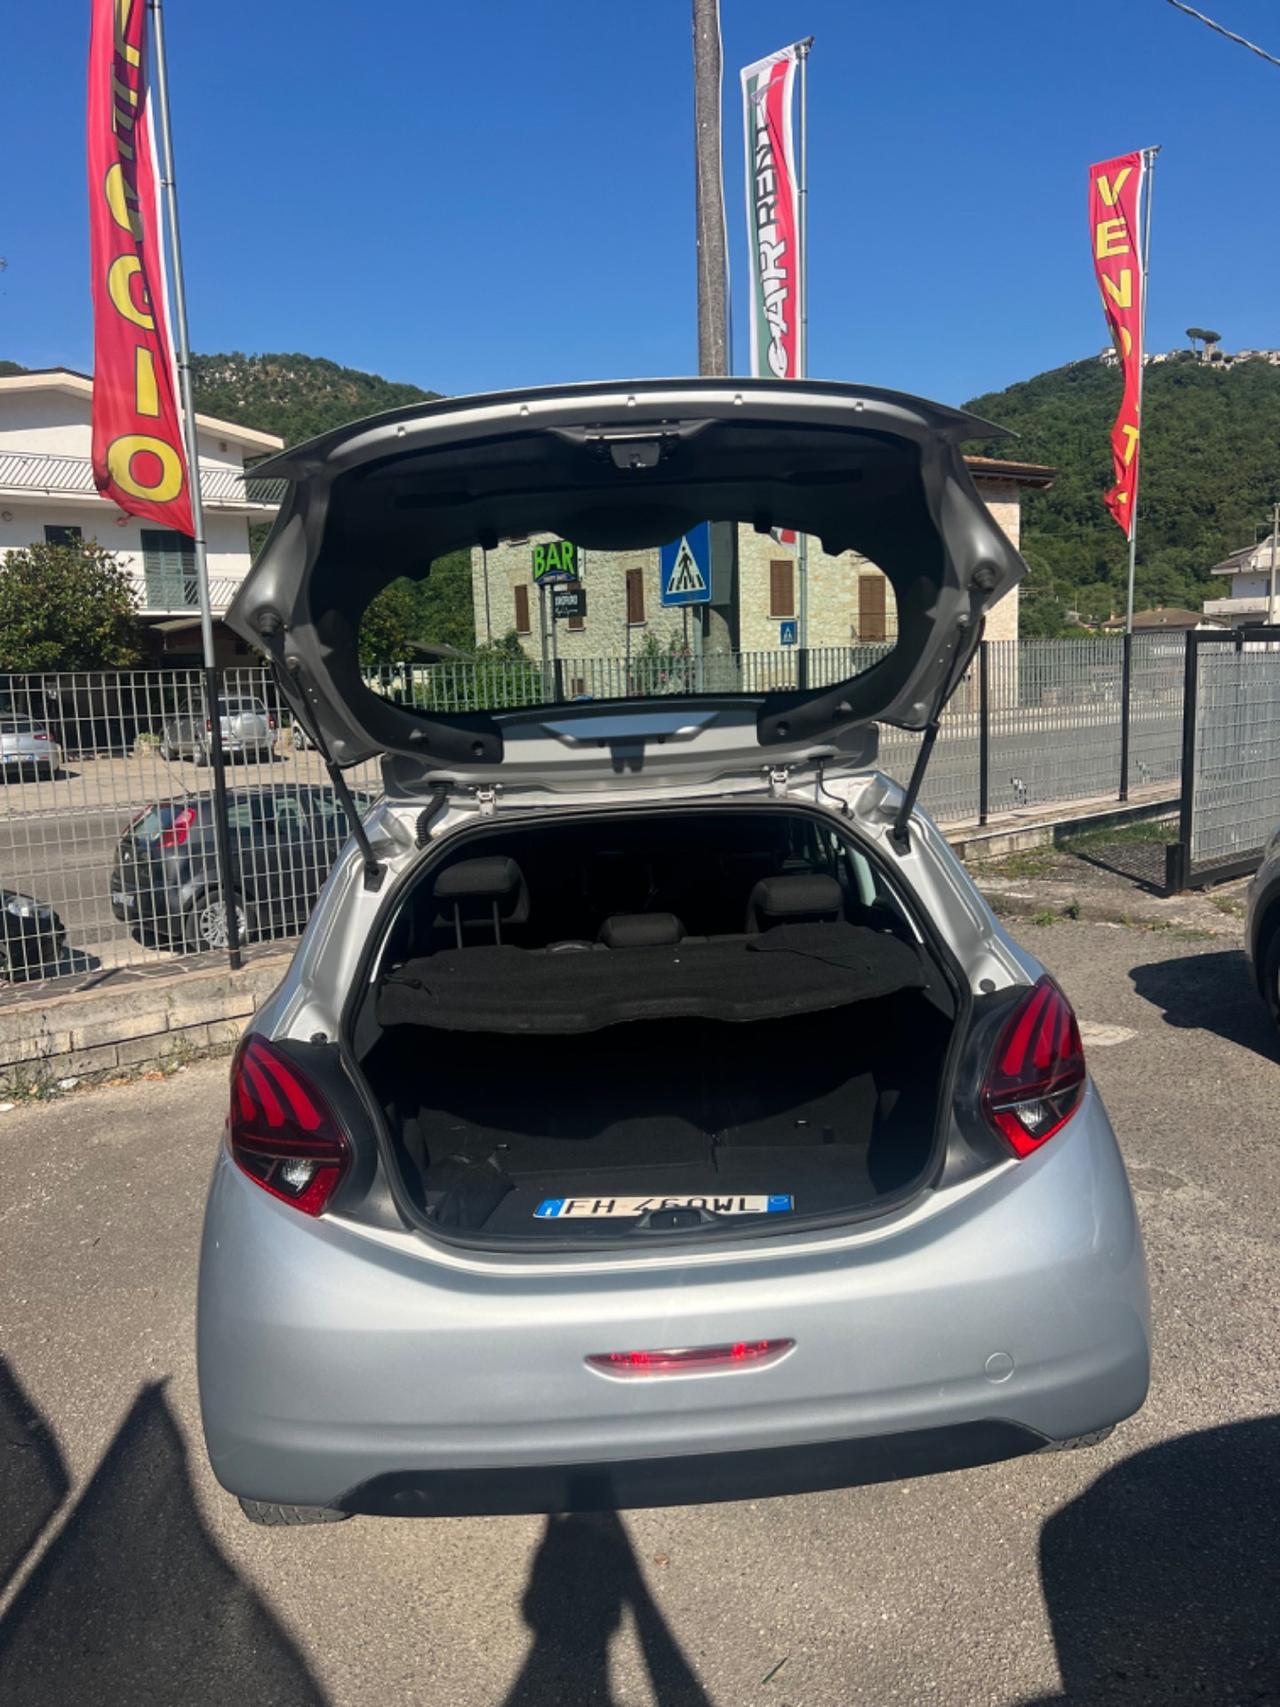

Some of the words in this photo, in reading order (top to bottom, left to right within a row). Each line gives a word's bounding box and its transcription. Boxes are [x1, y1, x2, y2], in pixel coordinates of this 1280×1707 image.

[1096, 167, 1139, 504] VENT
[534, 541, 575, 579] BAR
[565, 1199, 616, 1214] FH
